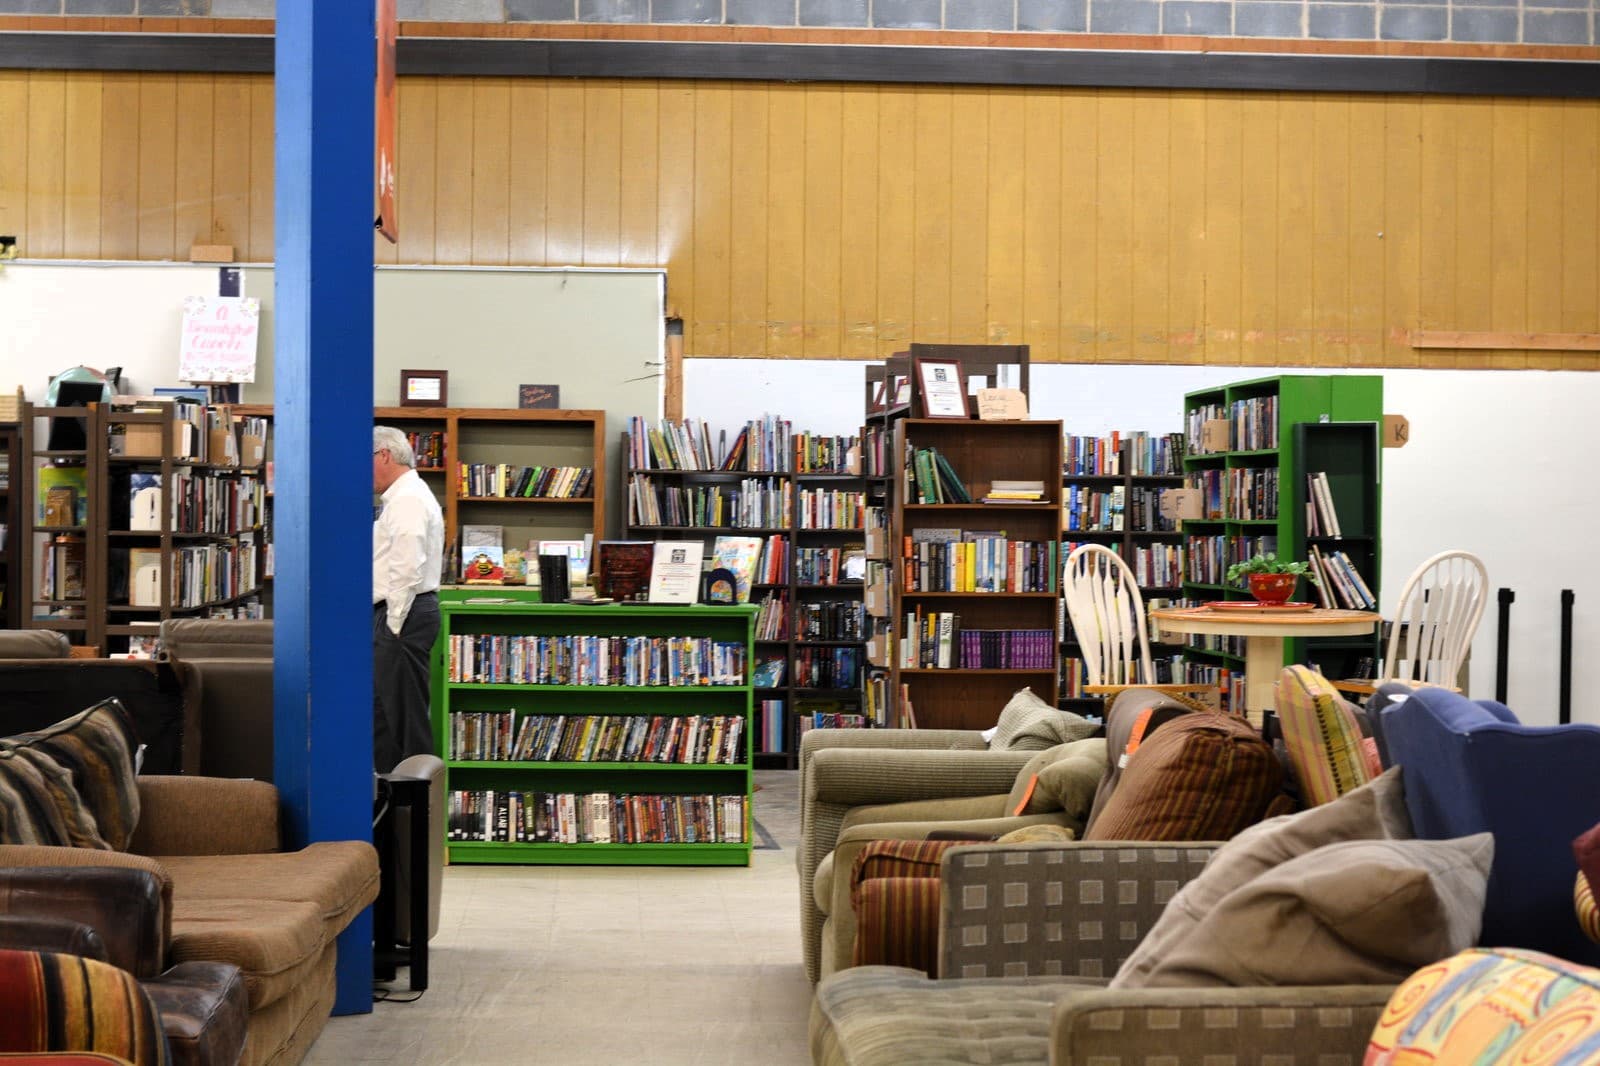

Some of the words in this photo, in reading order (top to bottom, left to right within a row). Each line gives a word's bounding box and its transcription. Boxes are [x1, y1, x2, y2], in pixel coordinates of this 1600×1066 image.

[1202, 427, 1211, 443] H
[1395, 423, 1406, 441] K
[1160, 495, 1169, 511] E
[1176, 495, 1185, 511] F
